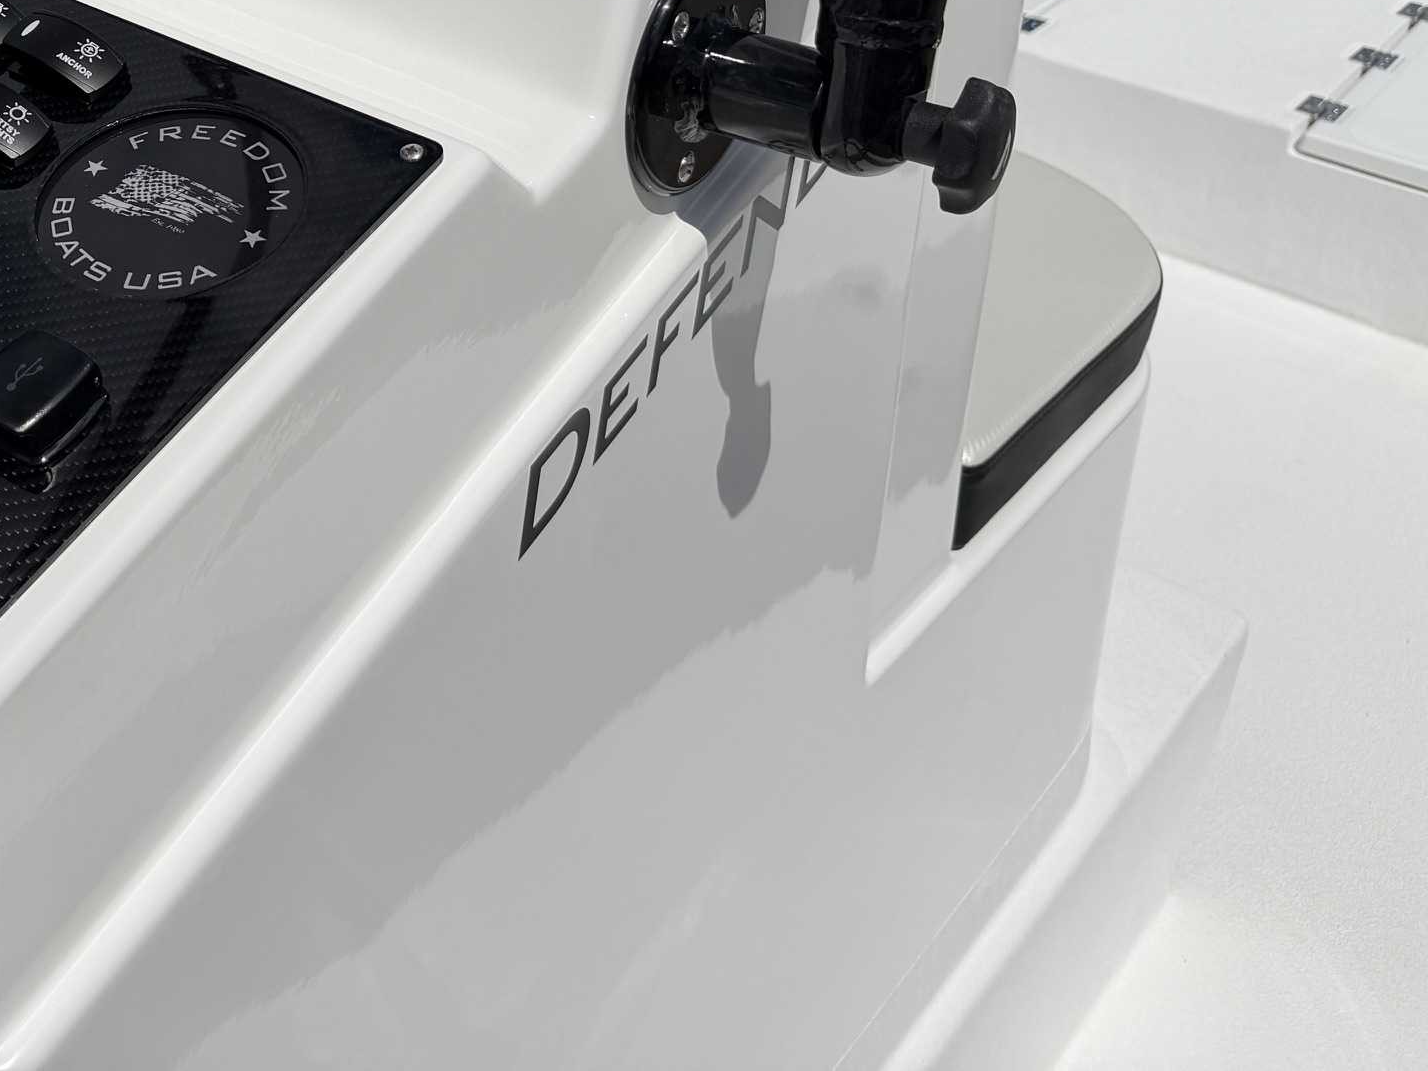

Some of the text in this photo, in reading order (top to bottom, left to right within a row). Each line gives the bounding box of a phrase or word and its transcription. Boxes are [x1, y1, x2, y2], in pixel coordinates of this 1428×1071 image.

[56, 52, 92, 79] ANCHOR
[128, 124, 291, 211] FREEDOM
[51, 197, 217, 290] BOATS USA
